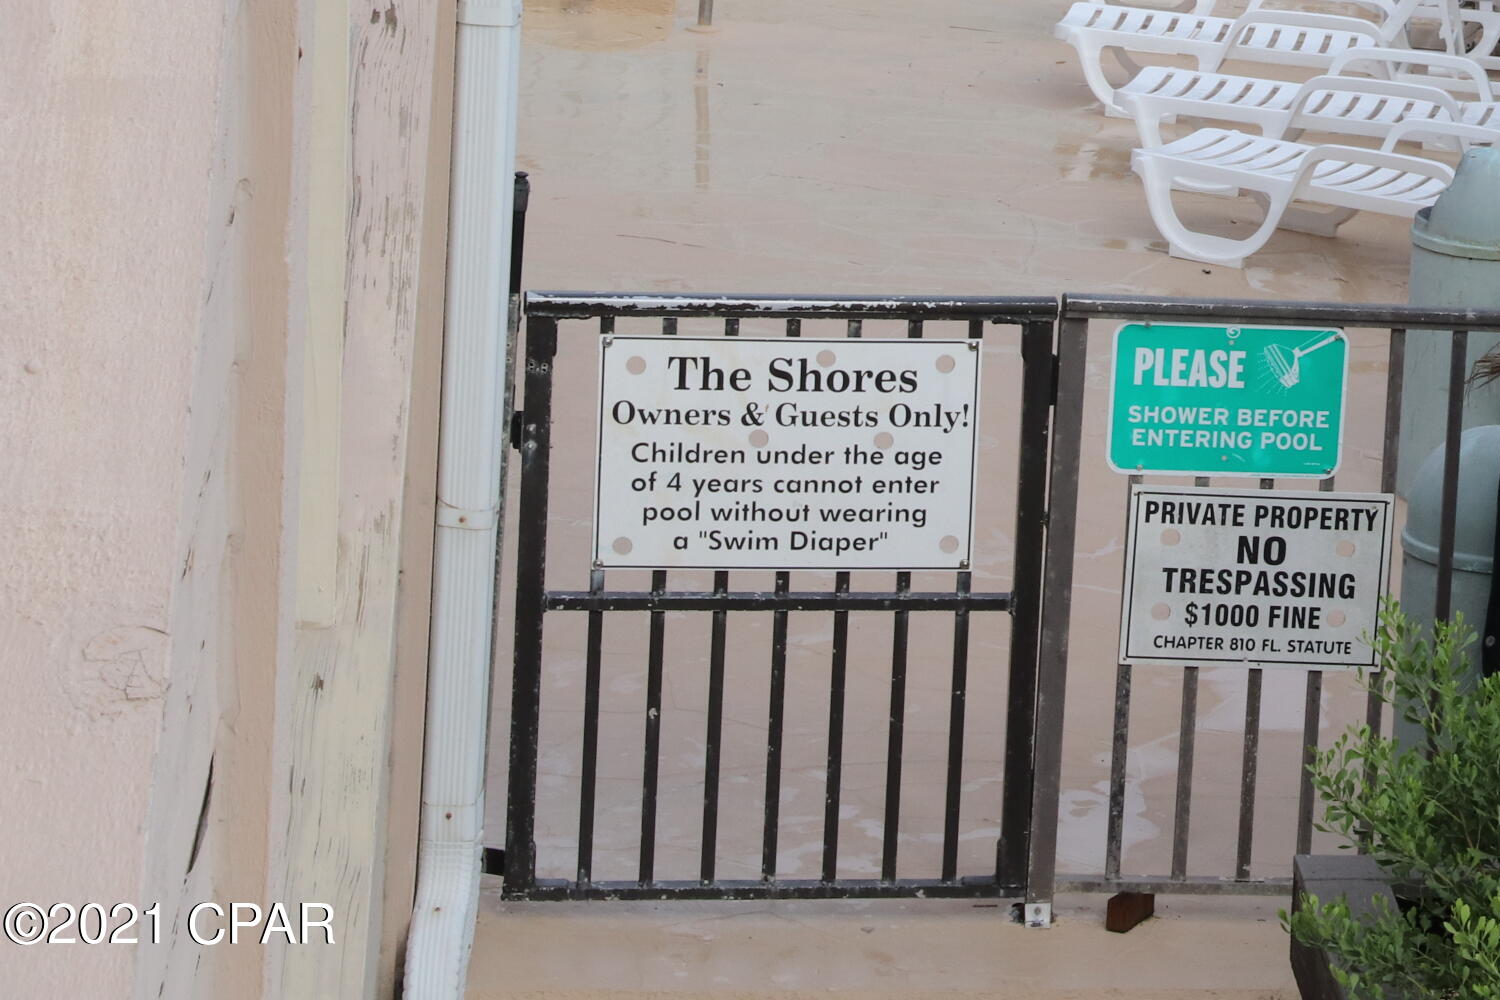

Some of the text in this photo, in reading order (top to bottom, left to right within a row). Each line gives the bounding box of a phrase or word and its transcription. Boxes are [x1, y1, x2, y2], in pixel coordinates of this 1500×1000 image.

[668, 357, 917, 393] The Shores
[1134, 348, 1246, 388] PLEASE
[613, 401, 968, 433] Owners & Guests Only!
[1128, 405, 1329, 428] SHOWER BEFORE
[1133, 429, 1322, 450] ENTERING POOL
[632, 442, 942, 470] Children under the age
[632, 471, 939, 497] of 4 years cannot enter
[643, 501, 926, 527] pool without wearing
[1145, 501, 1378, 531] PRIVATE PROPERTY
[674, 530, 887, 556] a "Swim Diaper"
[1237, 536, 1286, 565] NO
[1163, 568, 1355, 599] TRESPASSING
[1185, 602, 1321, 629] $1000 FINE
[1154, 635, 1351, 654] CHAPTER 810 FL. STATUTE
